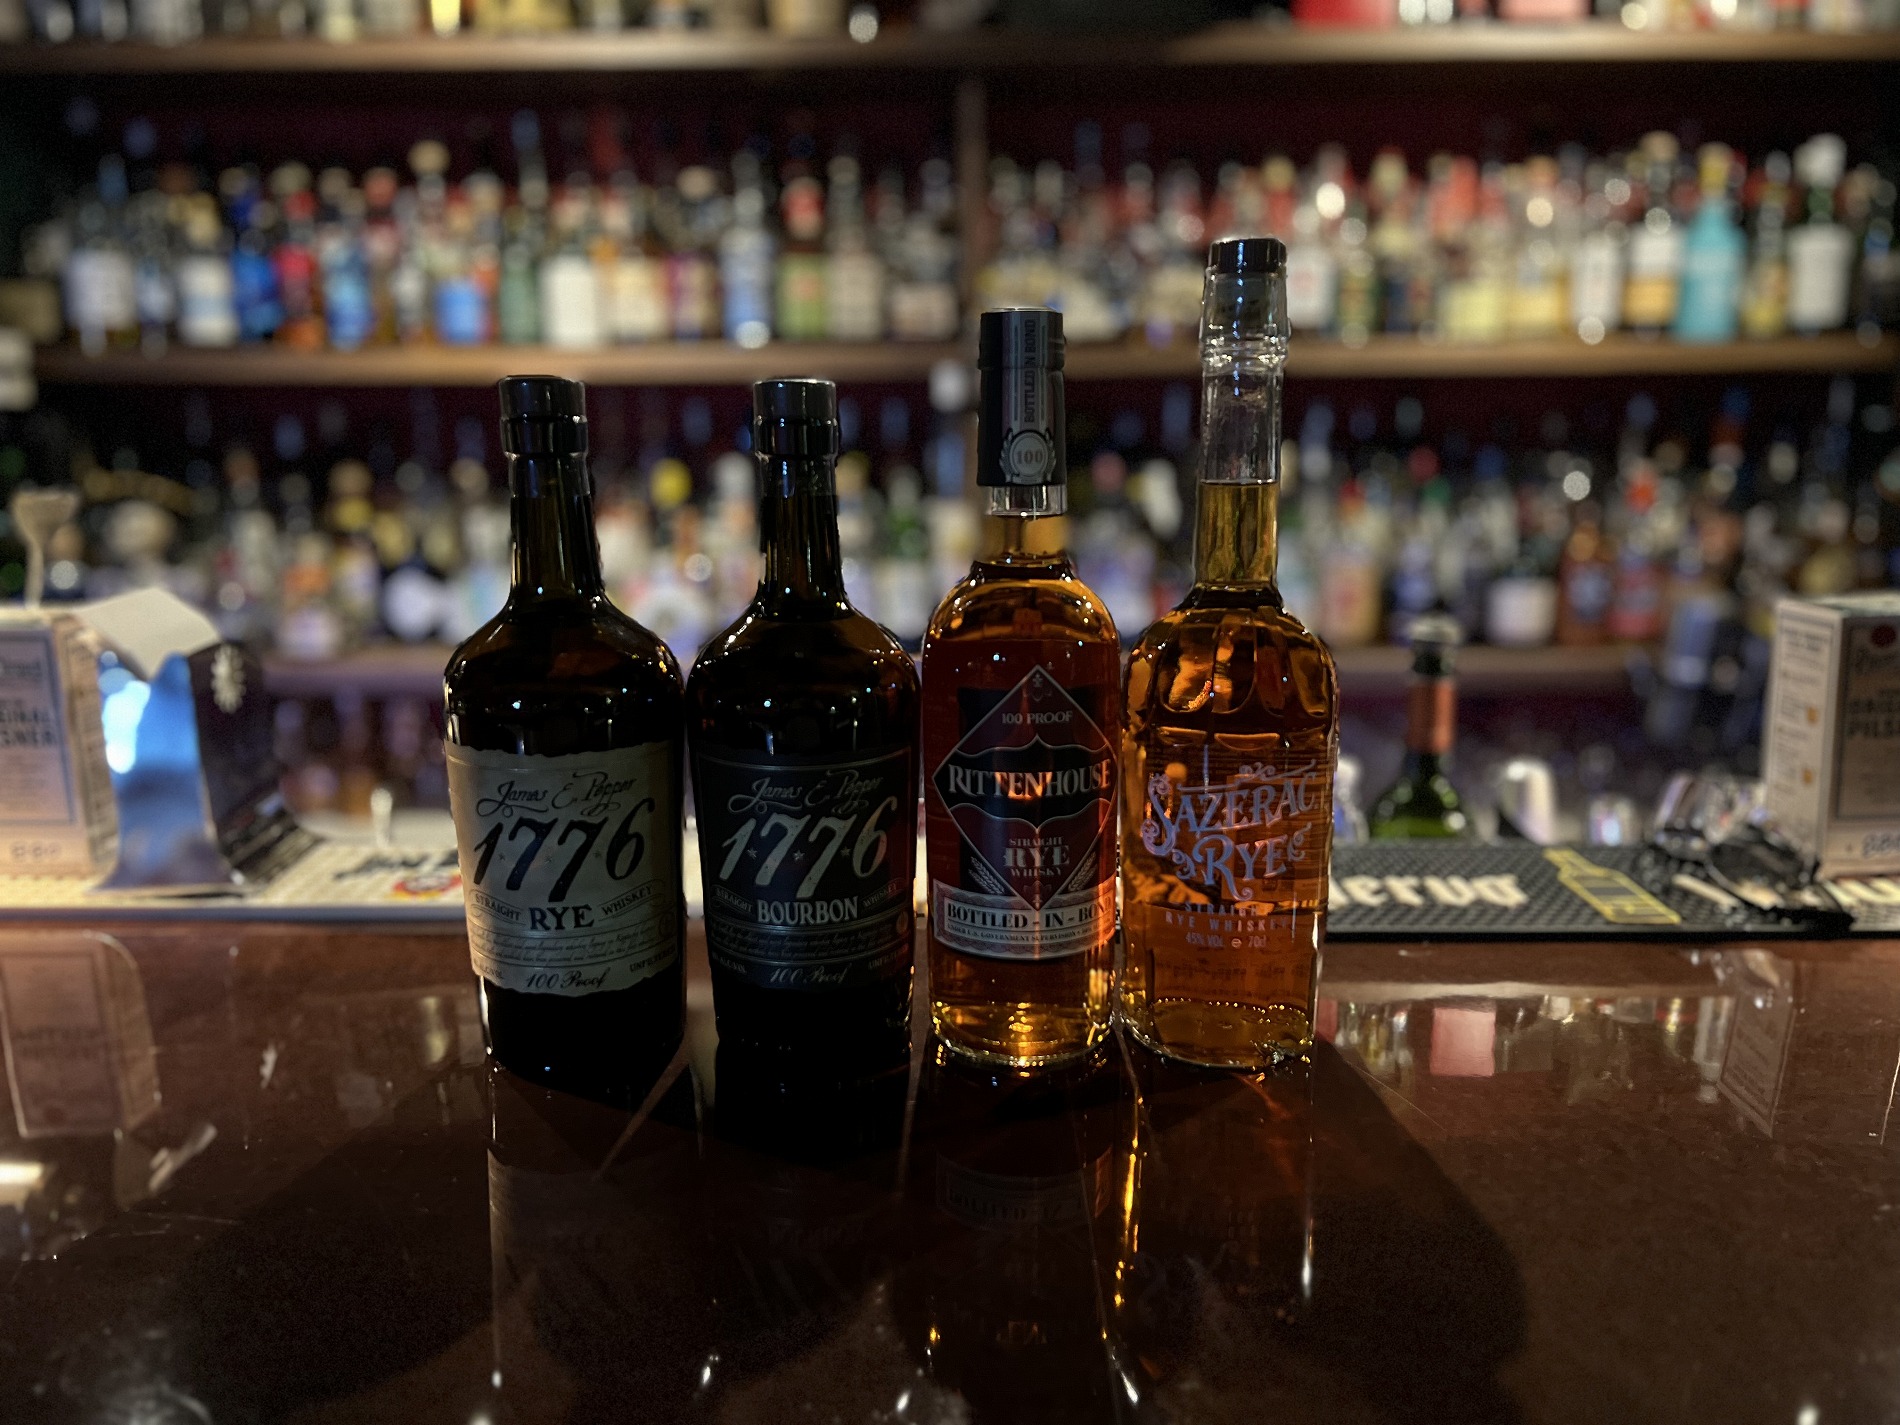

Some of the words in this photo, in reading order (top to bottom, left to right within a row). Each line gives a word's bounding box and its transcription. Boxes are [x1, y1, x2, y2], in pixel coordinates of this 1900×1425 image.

[1024, 318, 1037, 353] BOND
[1024, 371, 1035, 423] BOTTLED
[1016, 450, 1044, 465] 100
[1001, 712, 1023, 726] 100
[1026, 710, 1073, 725] PROOF
[476, 780, 550, 817] James
[573, 771, 638, 817] Pepper
[727, 777, 803, 814] James
[825, 769, 884, 815] Pepper
[948, 757, 1112, 801] RITTENHOUSE
[1141, 771, 1316, 858] SAZERAC
[473, 797, 656, 903] 1776
[718, 795, 898, 900] 1776
[1003, 845, 1071, 868] RYE
[1008, 836, 1064, 847] STRAIGHT
[1010, 867, 1062, 878] WHISKY
[1191, 834, 1289, 902] RYE
[474, 893, 522, 922] STRAIGHT
[529, 904, 595, 931] RYE
[601, 885, 653, 916] WHISKEY
[715, 887, 753, 913] STRAIGHT
[756, 895, 859, 926] BOURBON
[947, 902, 1028, 929] BOTTLED
[1045, 911, 1064, 928] IN
[1165, 911, 1197, 929] RYE
[1208, 917, 1288, 933] WHISKEY
[525, 973, 558, 989] 100
[559, 967, 611, 989] Proof
[769, 967, 804, 984] 100
[804, 961, 853, 984] Proof
